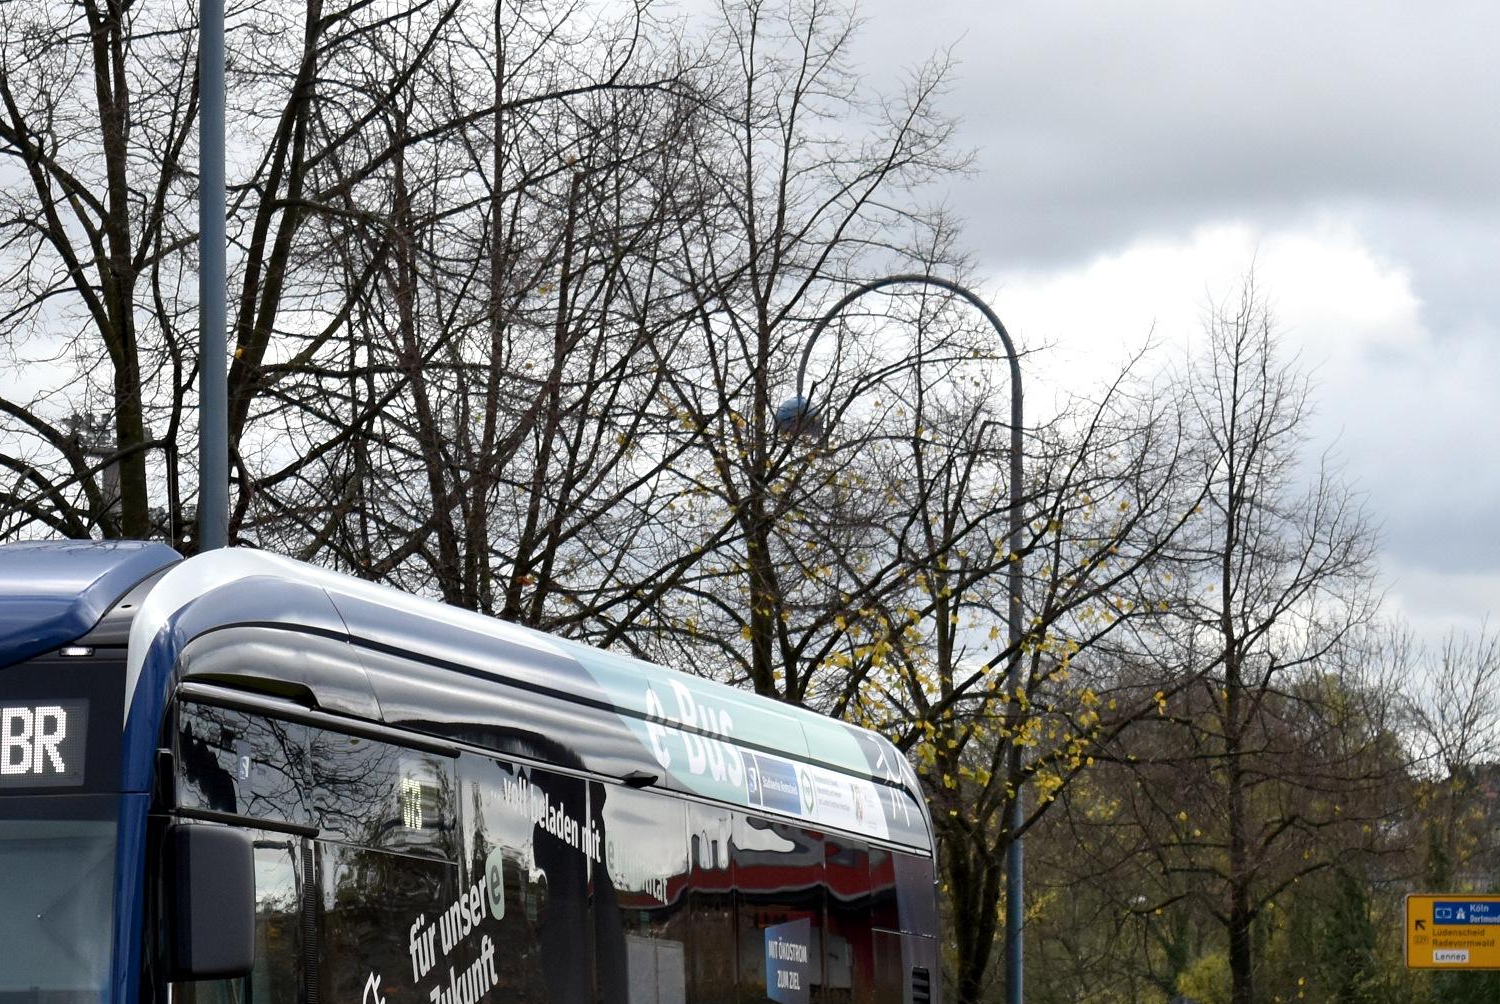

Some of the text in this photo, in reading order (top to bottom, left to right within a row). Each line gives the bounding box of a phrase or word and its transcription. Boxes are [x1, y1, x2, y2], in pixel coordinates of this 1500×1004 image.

[644, 678, 743, 788] e-Bus
[530, 782, 579, 849] beladen
[581, 819, 601, 864] mit
[1469, 904, 1490, 914] Köln
[408, 862, 502, 984] für unsere
[1432, 928, 1486, 937] Lüdenscheid
[1432, 939, 1495, 948] Radevormwald
[1435, 952, 1467, 961] Lennep
